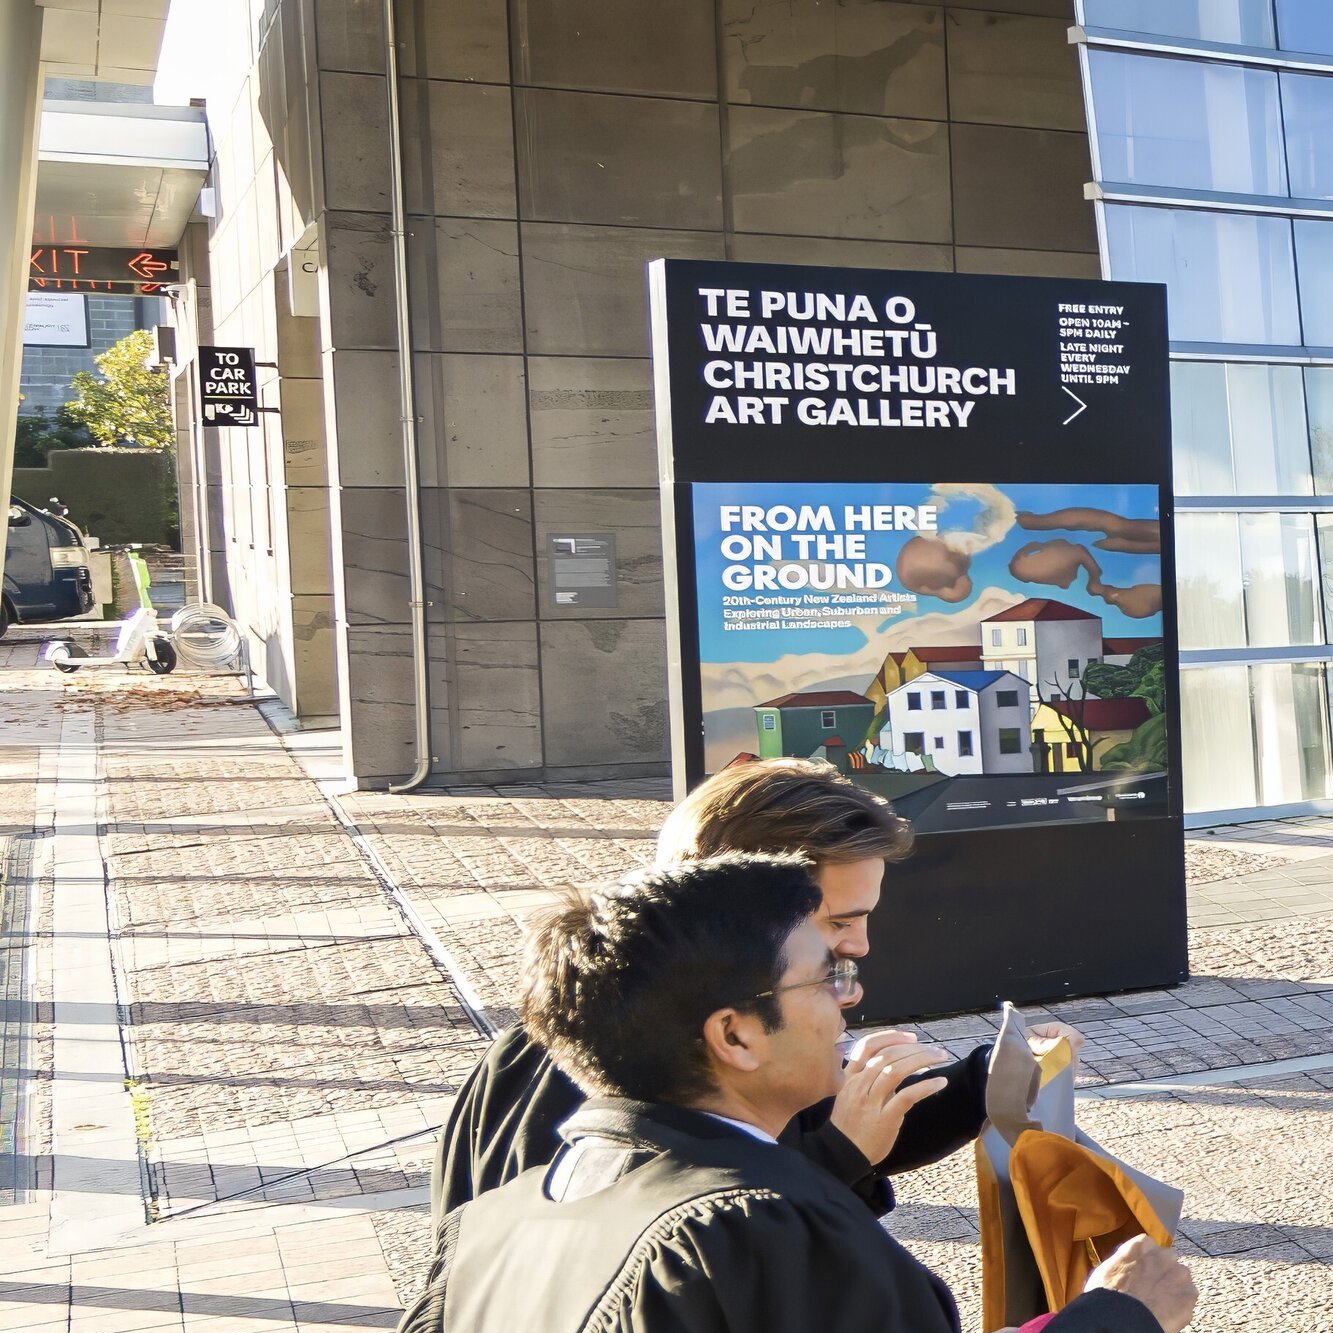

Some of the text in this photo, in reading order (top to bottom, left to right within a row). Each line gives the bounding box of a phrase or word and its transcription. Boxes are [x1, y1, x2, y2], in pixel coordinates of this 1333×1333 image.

[698, 288, 916, 324] TE PUNA O
[1058, 303, 1124, 315] FREE ENTRY
[1059, 317, 1090, 328] OPEN
[1059, 328, 1117, 339] 5PM DAILY
[700, 323, 938, 359] WAIWHETŪ
[1060, 341, 1124, 354] LATE NIGHT
[215, 352, 240, 366] TO
[1060, 352, 1096, 363] EVERY
[210, 367, 245, 380] CAR
[1060, 363, 1131, 375] WEDNESDAY
[703, 360, 1016, 396] CHRISTCHURCH
[1061, 374, 1119, 384] UNTIL 9PM
[205, 381, 252, 395] PARK
[705, 396, 976, 428] ART GALLERY
[719, 505, 938, 532] FROM HERE
[720, 534, 867, 561] ON THE
[721, 563, 893, 591] GROUND
[722, 593, 917, 606] 20th-Century New Zealand Artists
[723, 607, 780, 620] Exploring
[822, 606, 878, 617] Suburban
[879, 605, 902, 615] and
[724, 619, 852, 632] Industrial Landscapes
